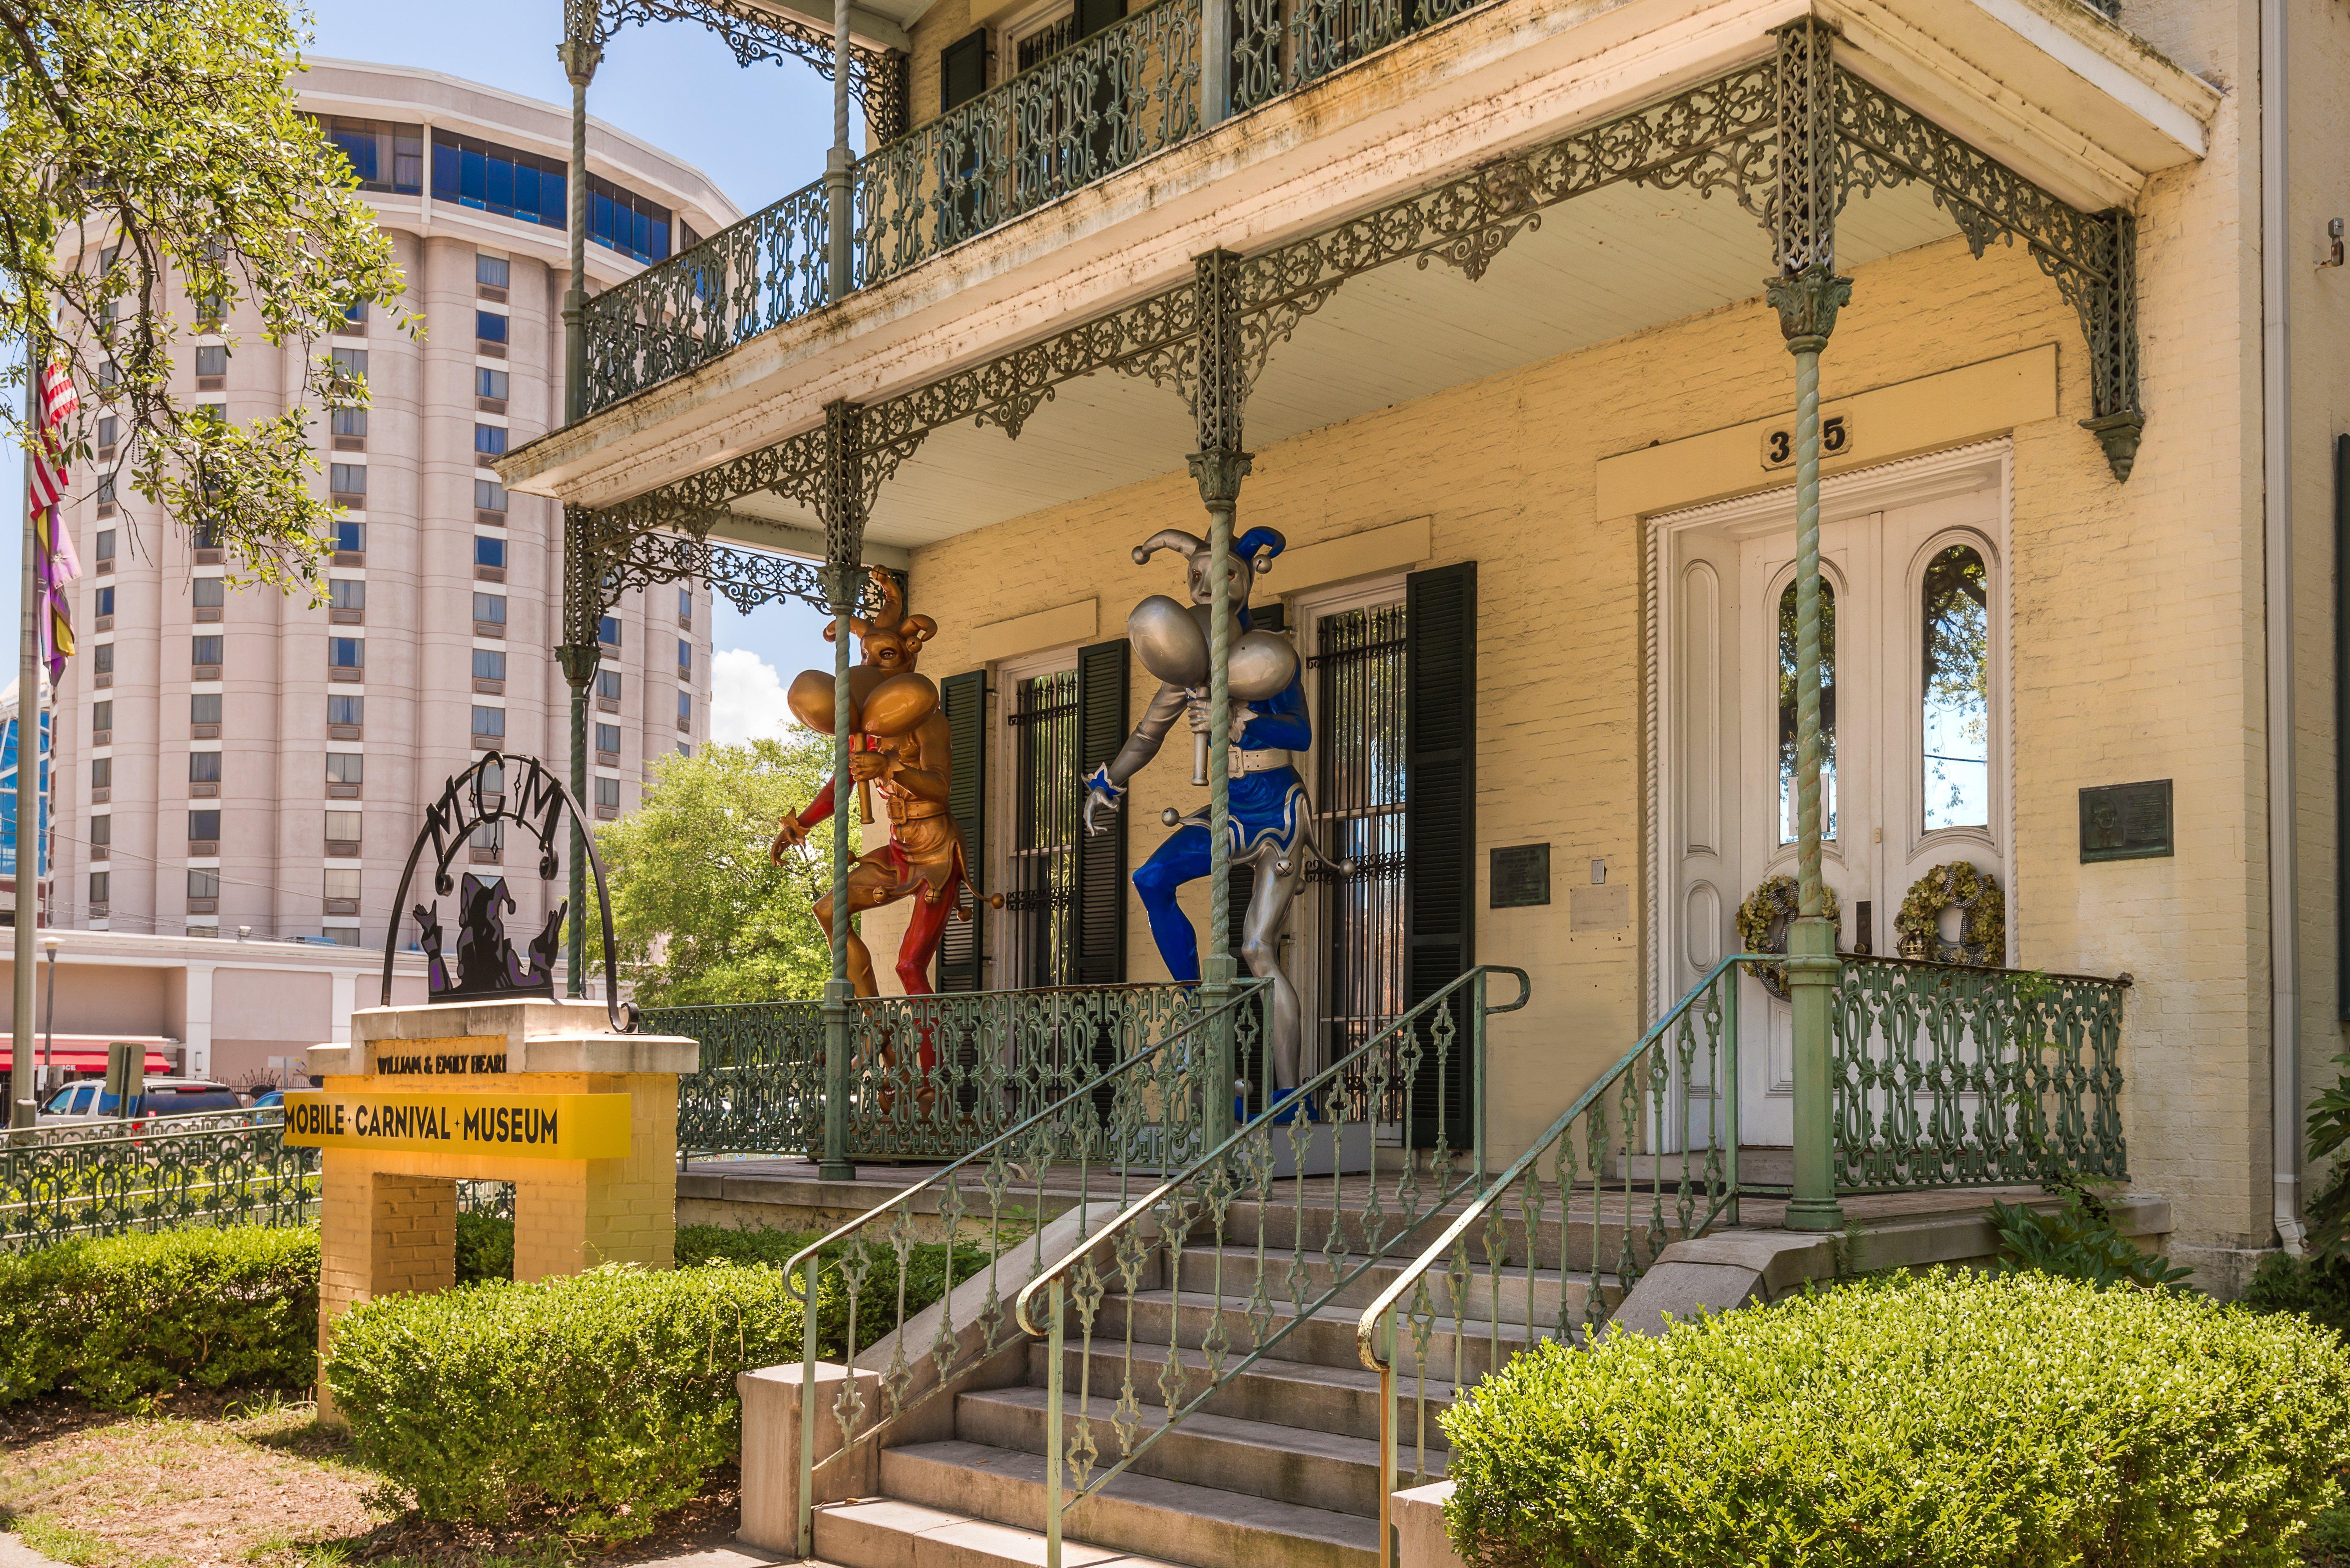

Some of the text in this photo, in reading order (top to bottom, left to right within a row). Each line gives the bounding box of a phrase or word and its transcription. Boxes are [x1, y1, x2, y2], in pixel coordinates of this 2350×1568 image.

[1770, 416, 1845, 463] 35
[427, 750, 565, 864] MCM
[377, 1055, 423, 1075] WILLIAM
[424, 1056, 433, 1074] &
[436, 1054, 469, 1074] EMILY
[284, 1103, 558, 1144] MOBILE CARNIVAL MUSEUM
